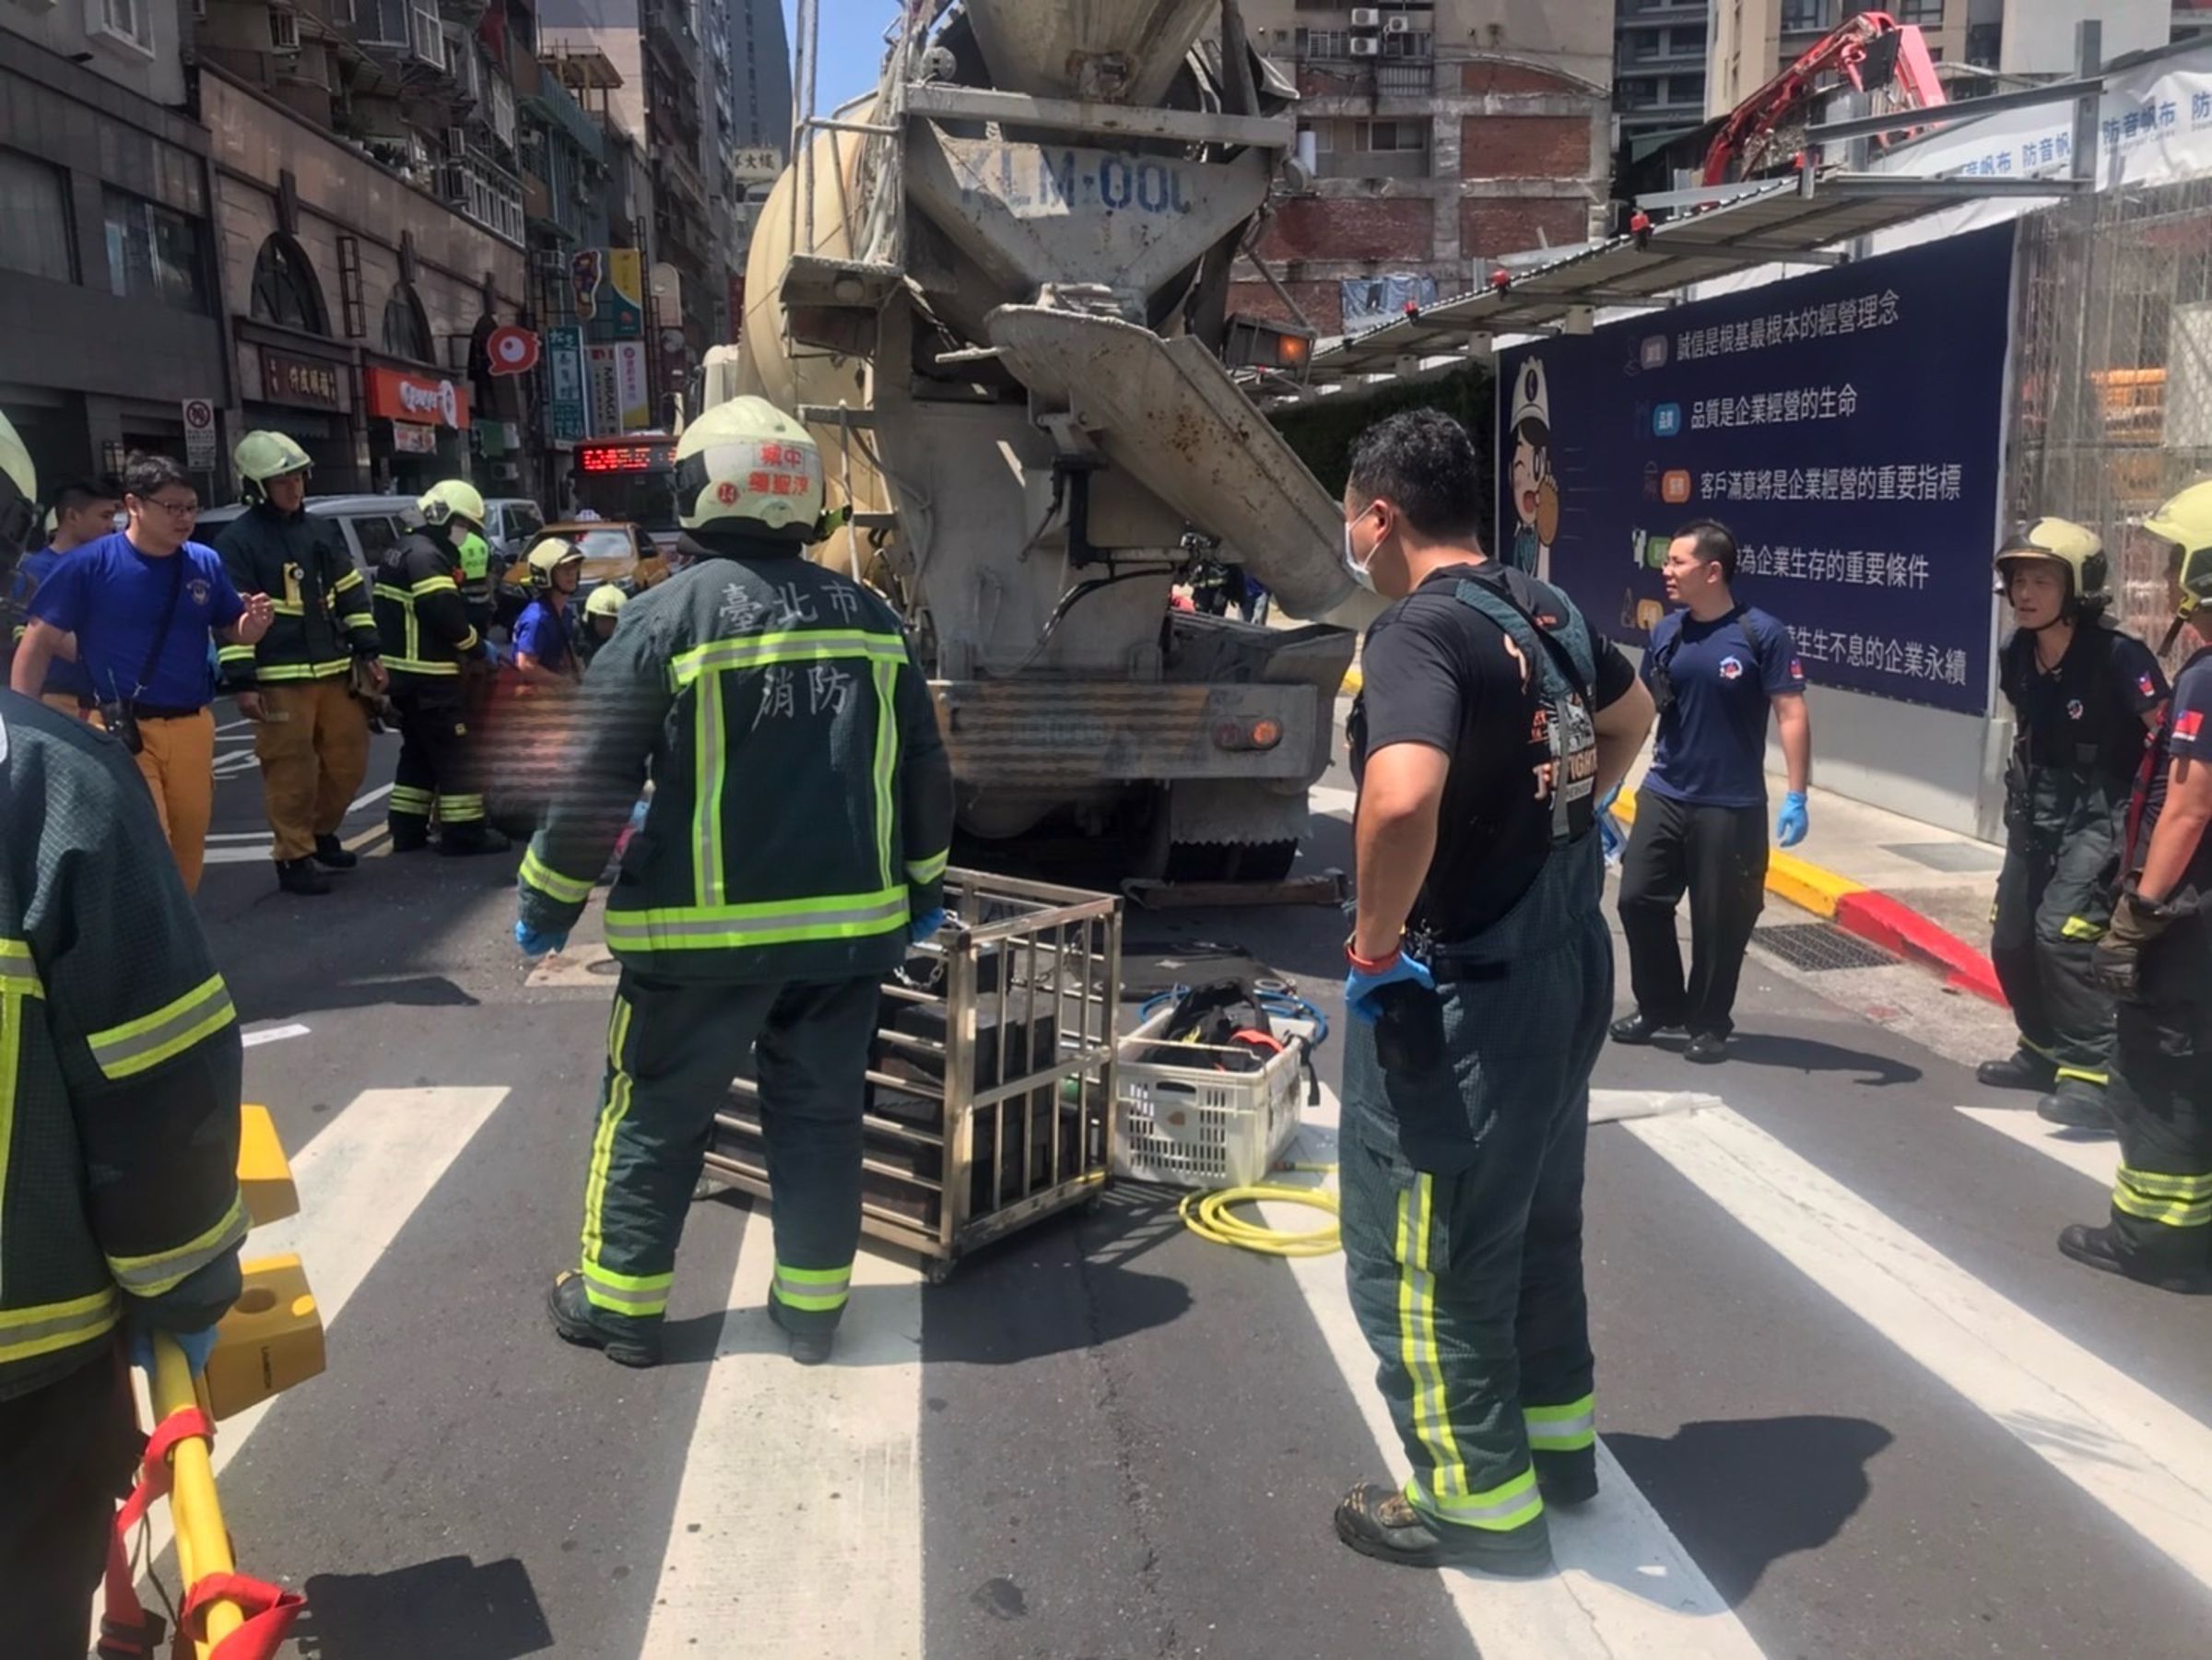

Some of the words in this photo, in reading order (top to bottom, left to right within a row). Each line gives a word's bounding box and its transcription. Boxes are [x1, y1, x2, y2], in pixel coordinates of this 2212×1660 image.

[2102, 100, 2177, 144] 防音帆布
[1690, 383, 1858, 430] 品質是企業經營的生命
[720, 581, 858, 633] 臺北市
[752, 665, 851, 733] 消防
